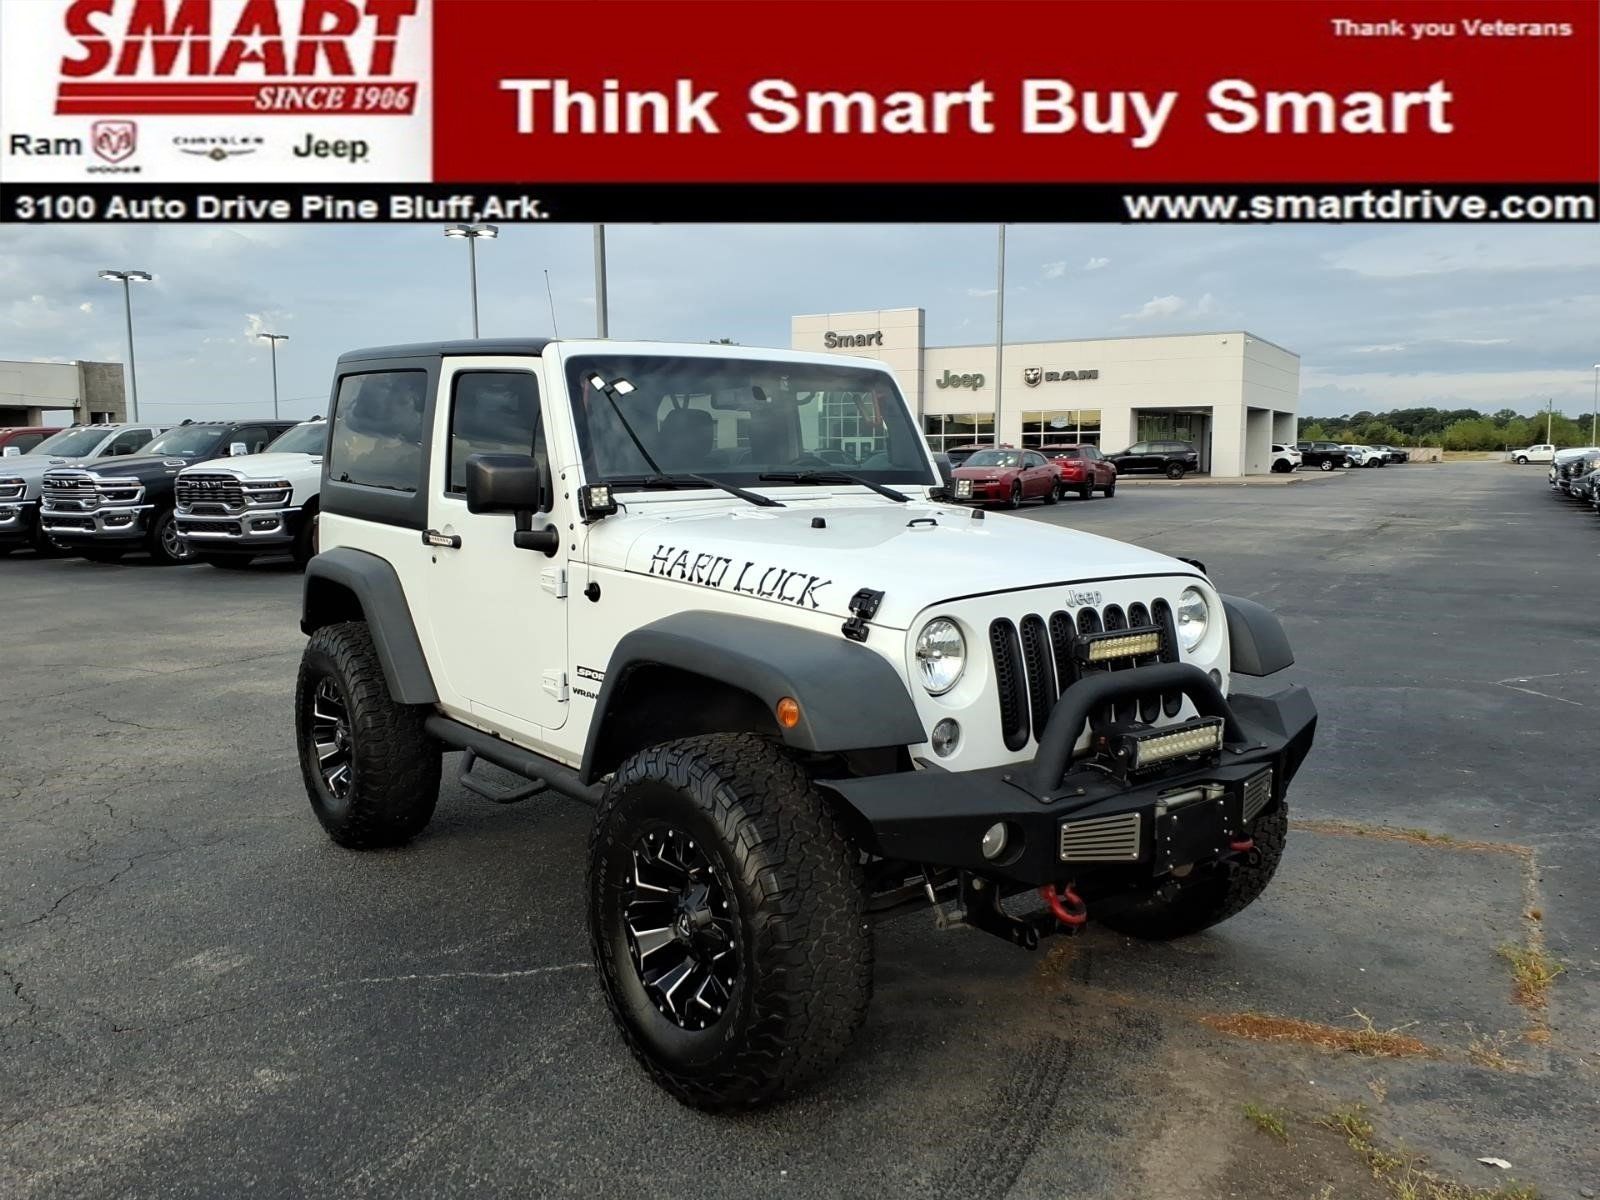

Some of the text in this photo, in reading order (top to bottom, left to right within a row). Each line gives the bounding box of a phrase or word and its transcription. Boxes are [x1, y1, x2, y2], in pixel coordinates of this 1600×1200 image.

[824, 330, 883, 349] Smart
[935, 369, 986, 392] Jeep
[1045, 369, 1098, 382] RAM
[649, 545, 832, 608] HARD LUCK
[1066, 590, 1102, 608] Jeep
[577, 668, 605, 681] SPOR
[572, 687, 599, 700] WRAN
